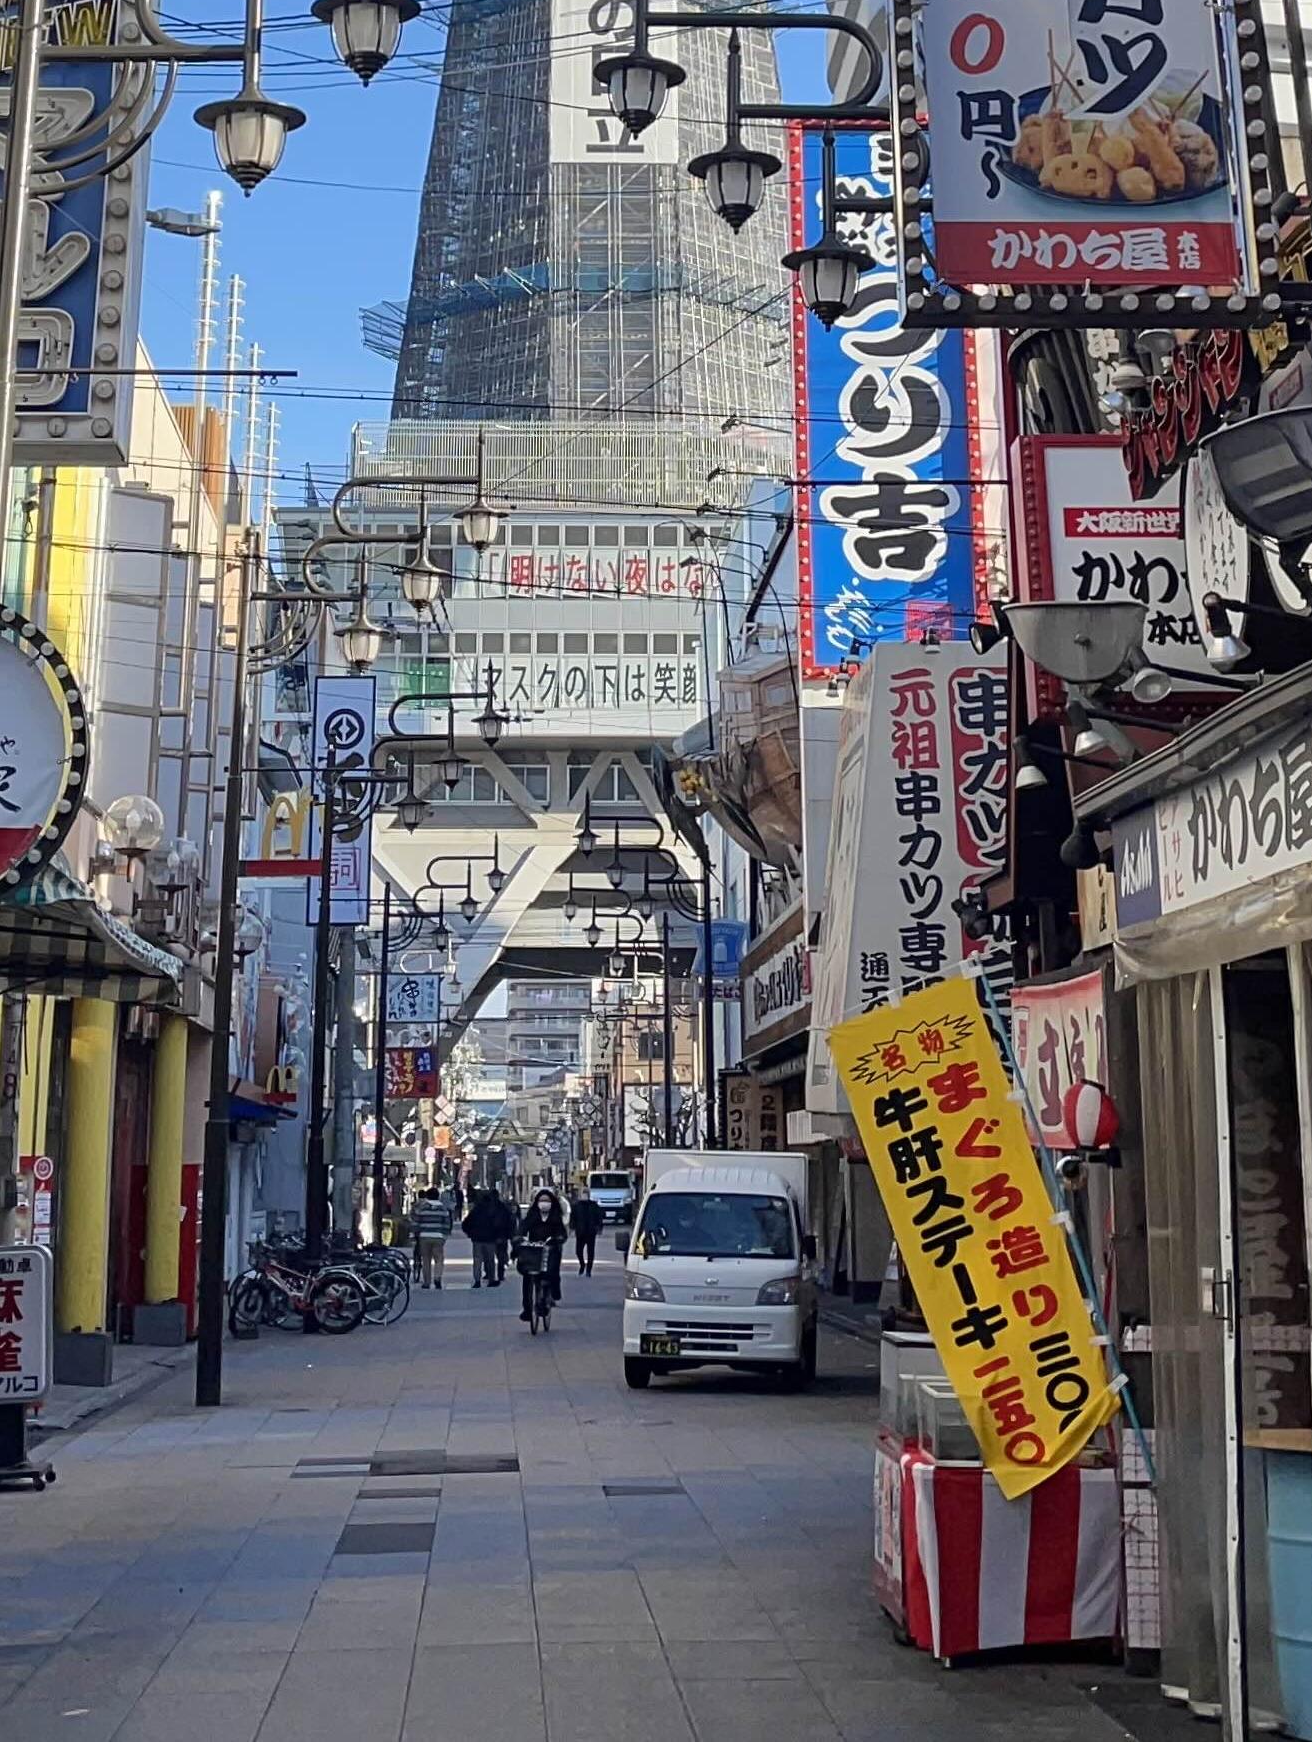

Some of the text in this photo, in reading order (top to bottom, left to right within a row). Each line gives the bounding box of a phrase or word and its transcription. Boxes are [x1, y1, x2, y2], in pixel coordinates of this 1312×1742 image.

[988, 228, 1171, 273] かわち屋
[1176, 231, 1201, 271] 本店
[1073, 550, 1190, 602] かわ
[879, 1024, 946, 1071] 名物
